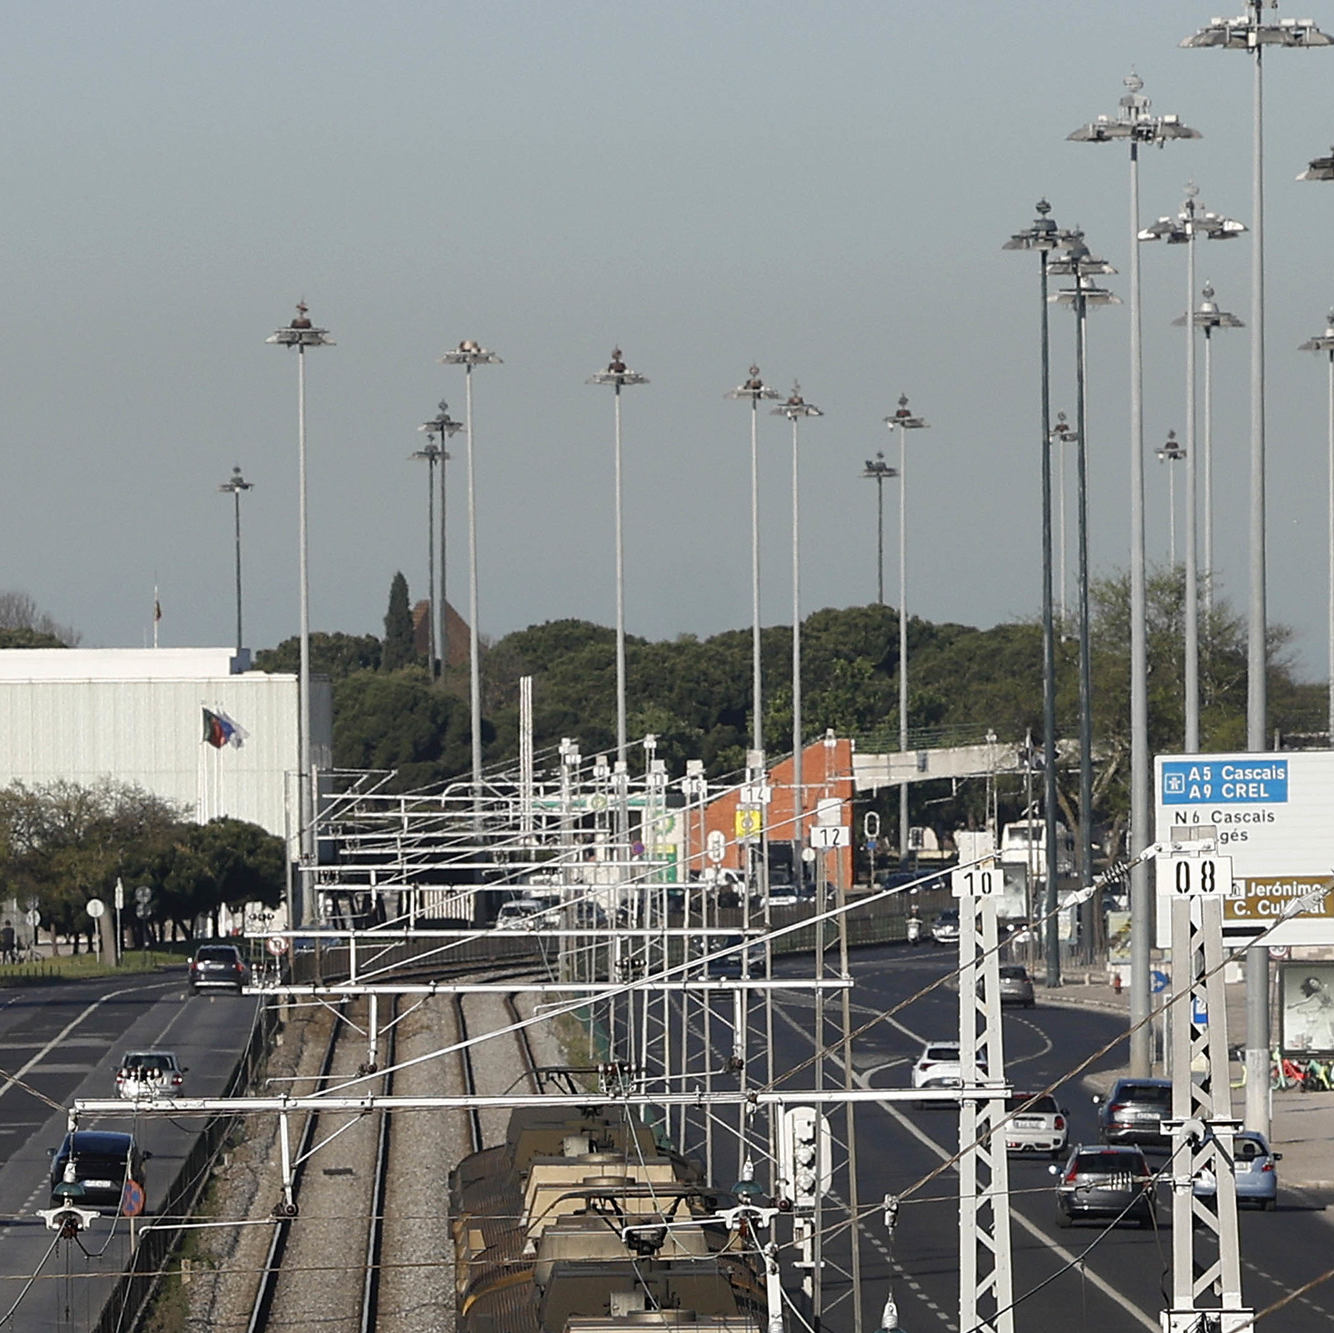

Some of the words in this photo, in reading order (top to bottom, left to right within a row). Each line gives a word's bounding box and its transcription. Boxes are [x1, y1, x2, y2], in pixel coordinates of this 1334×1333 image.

[1221, 764, 1285, 780] Cascais
[747, 788, 764, 801] 14
[1221, 783, 1269, 798] CREL
[1210, 809, 1275, 823] Cascais
[820, 828, 841, 846] 12
[963, 871, 992, 896] 10
[1175, 860, 1216, 894] 08
[1233, 901, 1251, 915] C.
